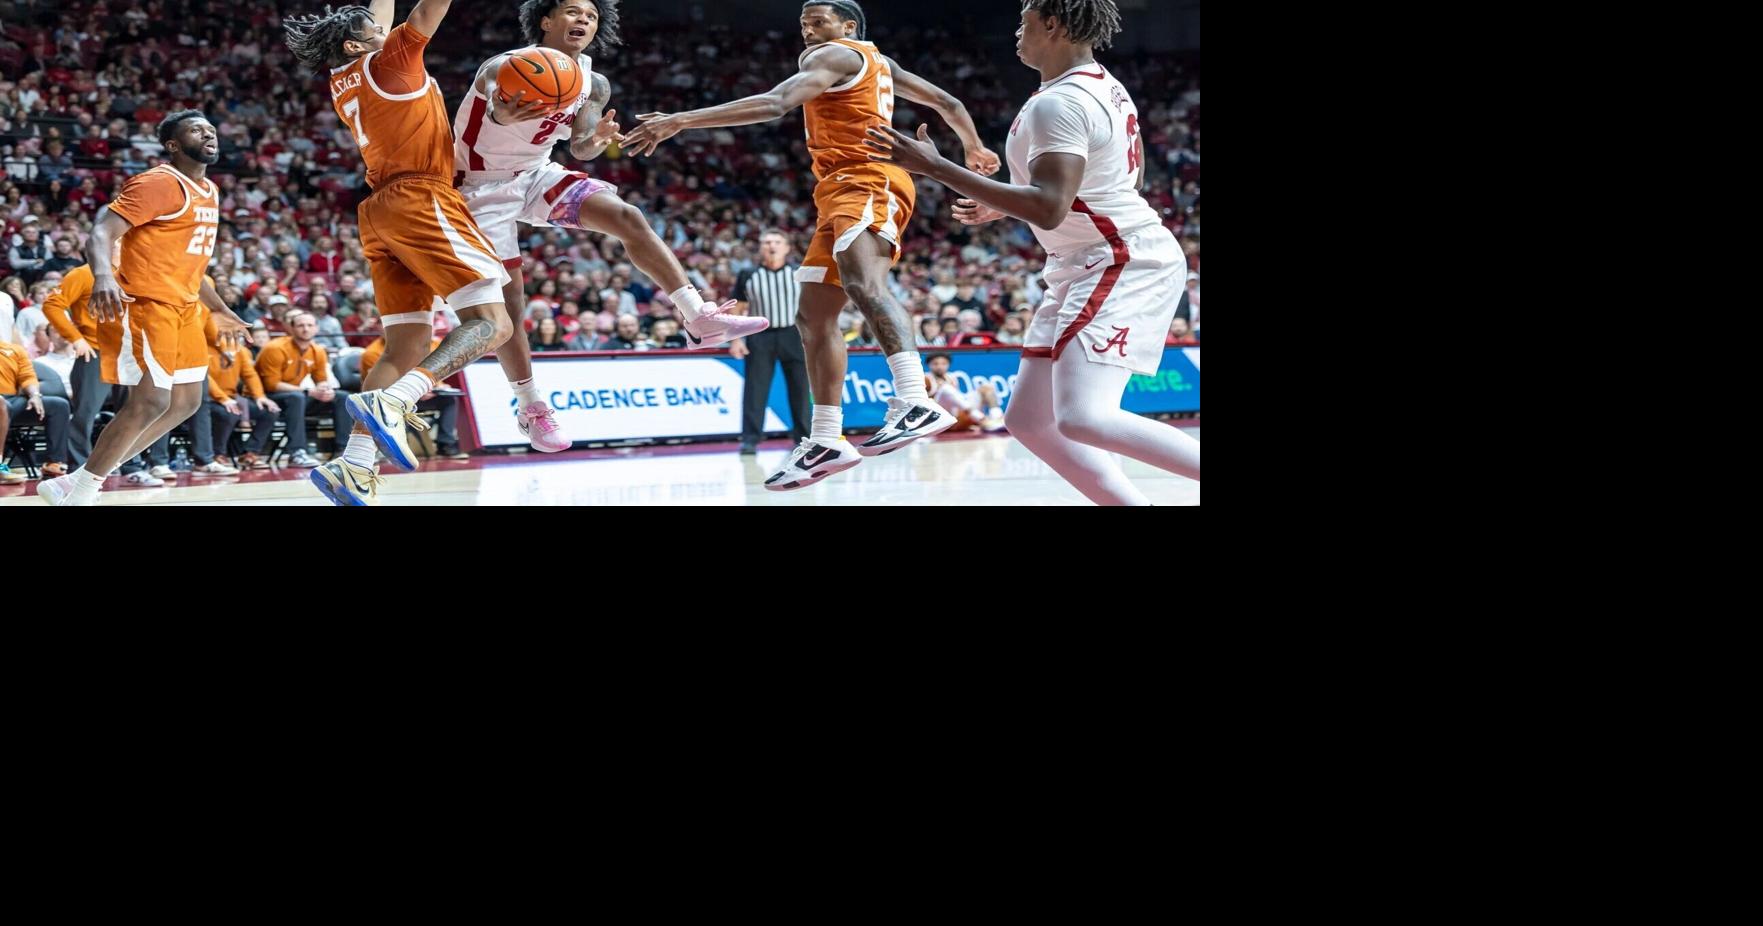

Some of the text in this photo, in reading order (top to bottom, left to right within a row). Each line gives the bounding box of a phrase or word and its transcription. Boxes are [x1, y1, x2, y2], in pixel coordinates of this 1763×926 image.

[342, 96, 370, 149] 7
[530, 120, 558, 145] 2
[185, 225, 217, 257] 23
[1092, 325, 1130, 357] A
[550, 386, 726, 410] CADENCE BANK
